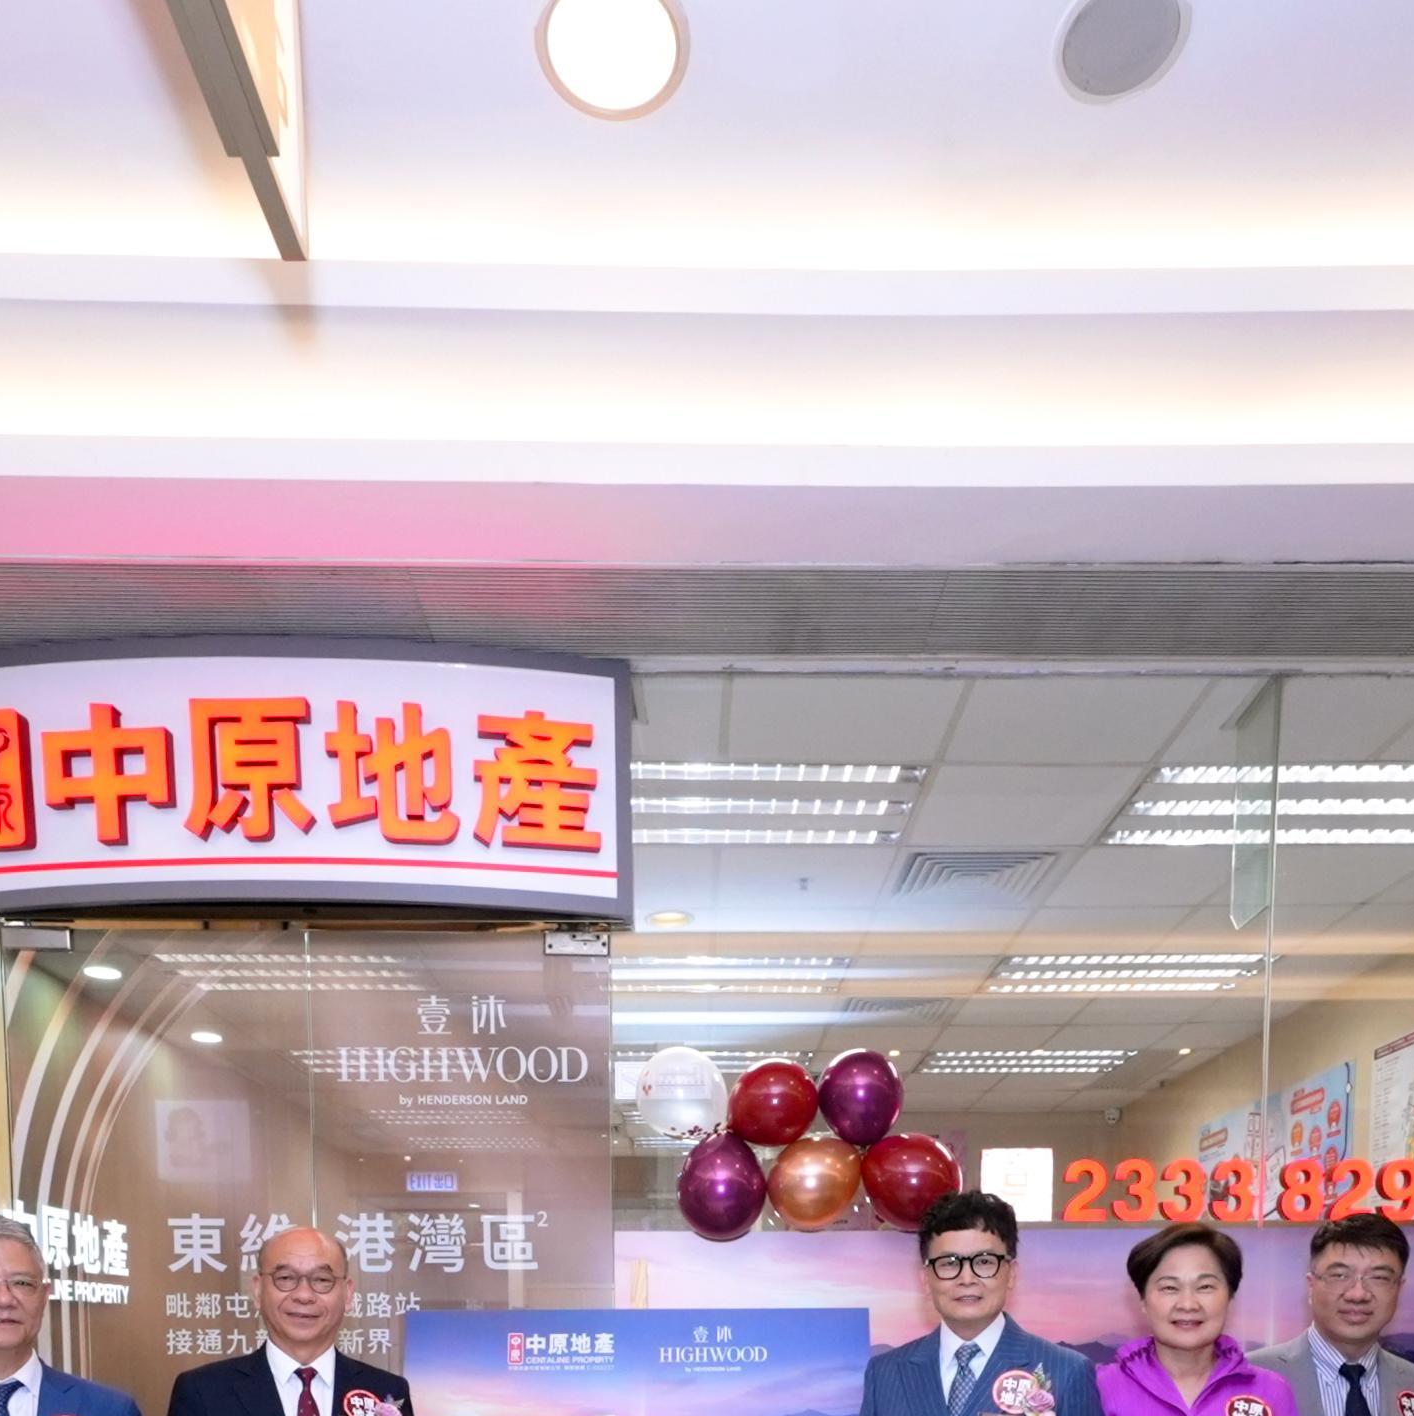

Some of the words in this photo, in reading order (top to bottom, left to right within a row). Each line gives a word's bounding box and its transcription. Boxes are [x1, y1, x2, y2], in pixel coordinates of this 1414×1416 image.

[40, 696, 603, 853] 中原地產
[335, 1046, 588, 1083] HIGHWOOD
[398, 1094, 413, 1107] by
[417, 1094, 492, 1105] HENDERSON
[495, 1094, 528, 1105] LAND
[409, 1174, 431, 1190] EXIT
[1063, 1157, 1256, 1222] 2333
[74, 1281, 130, 1305] PROPERTY
[525, 1333, 615, 1355] 中原地產
[525, 1356, 570, 1365] CENTALINE
[572, 1356, 615, 1364] PROPERTY
[659, 1346, 768, 1363] HIGHWOOD
[1234, 1400, 1265, 1416] 中原
